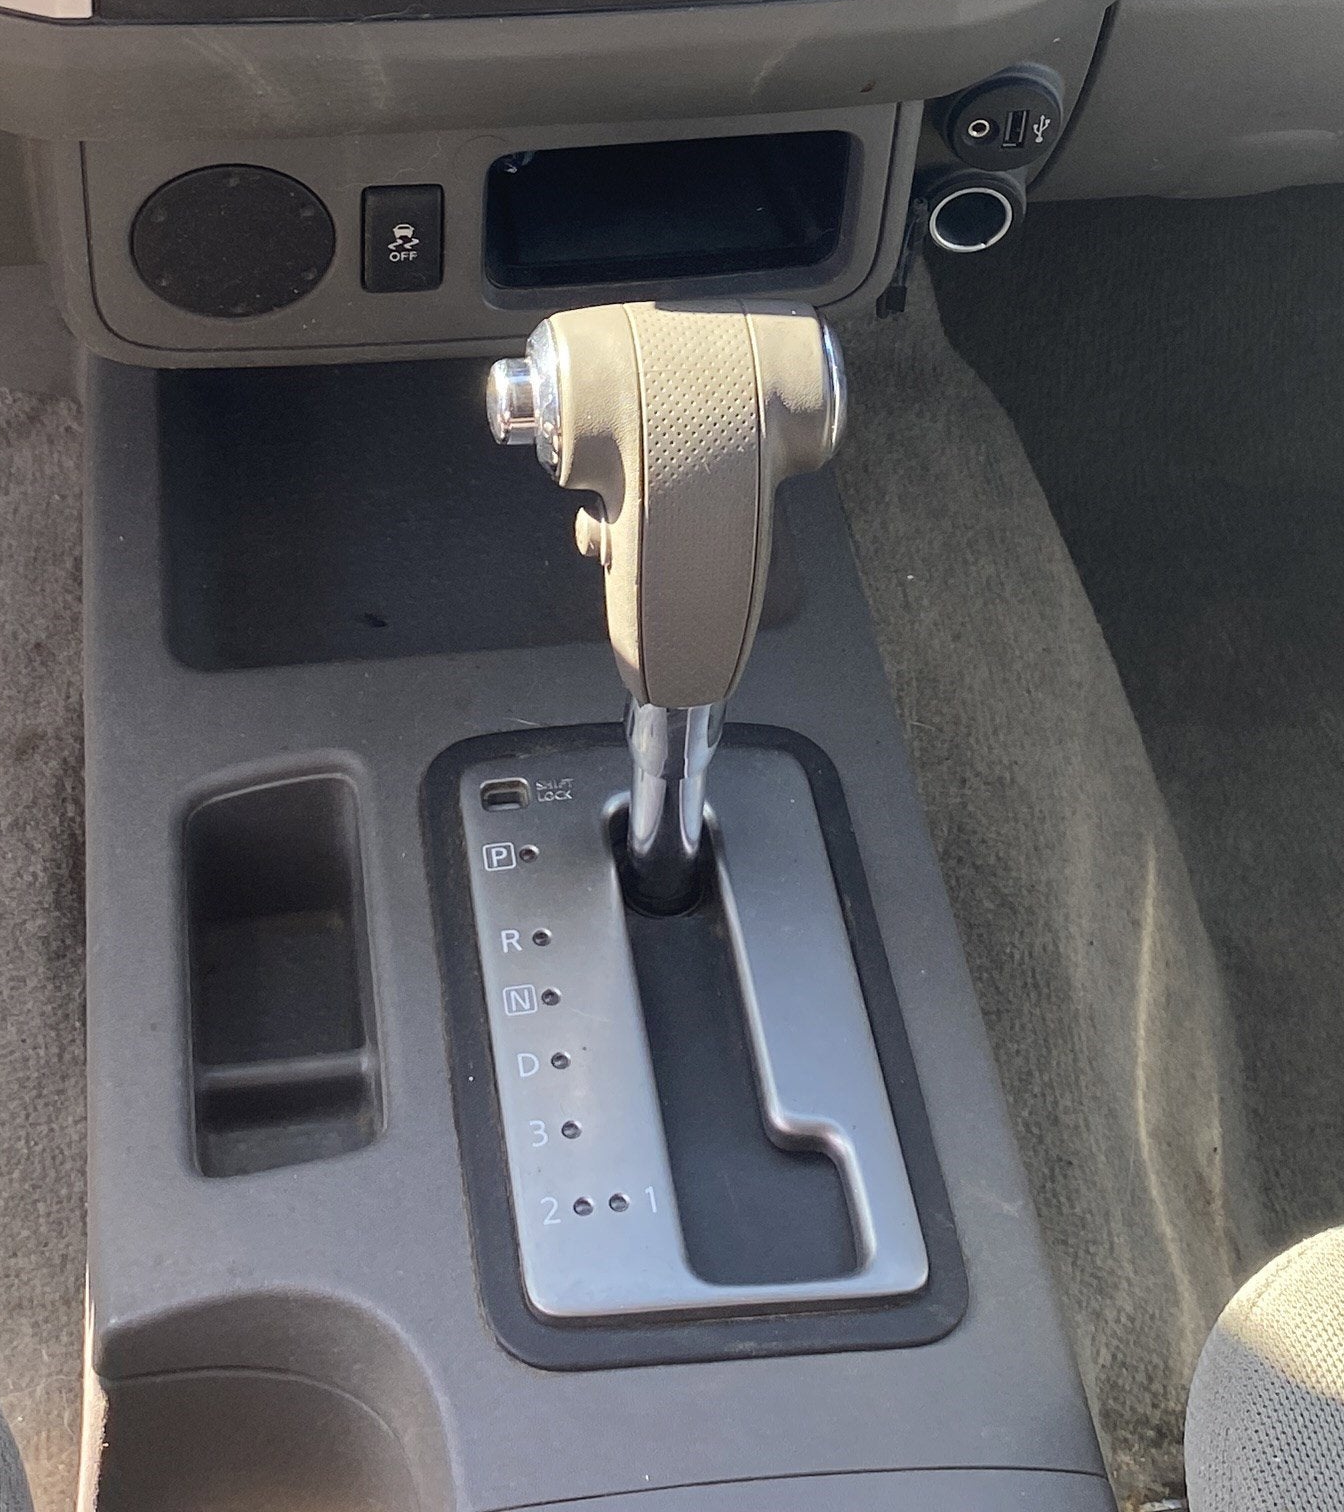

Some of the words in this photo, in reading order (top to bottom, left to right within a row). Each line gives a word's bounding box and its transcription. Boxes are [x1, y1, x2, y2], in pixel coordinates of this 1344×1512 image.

[389, 250, 418, 262] OFF
[537, 790, 573, 803] LOCK
[490, 847, 509, 868] P
[500, 929, 523, 953] R
[509, 988, 531, 1012] N
[516, 1052, 540, 1078] D
[529, 1119, 549, 1147] 3
[540, 1196, 561, 1226] 2
[644, 1185, 658, 1214] 1
